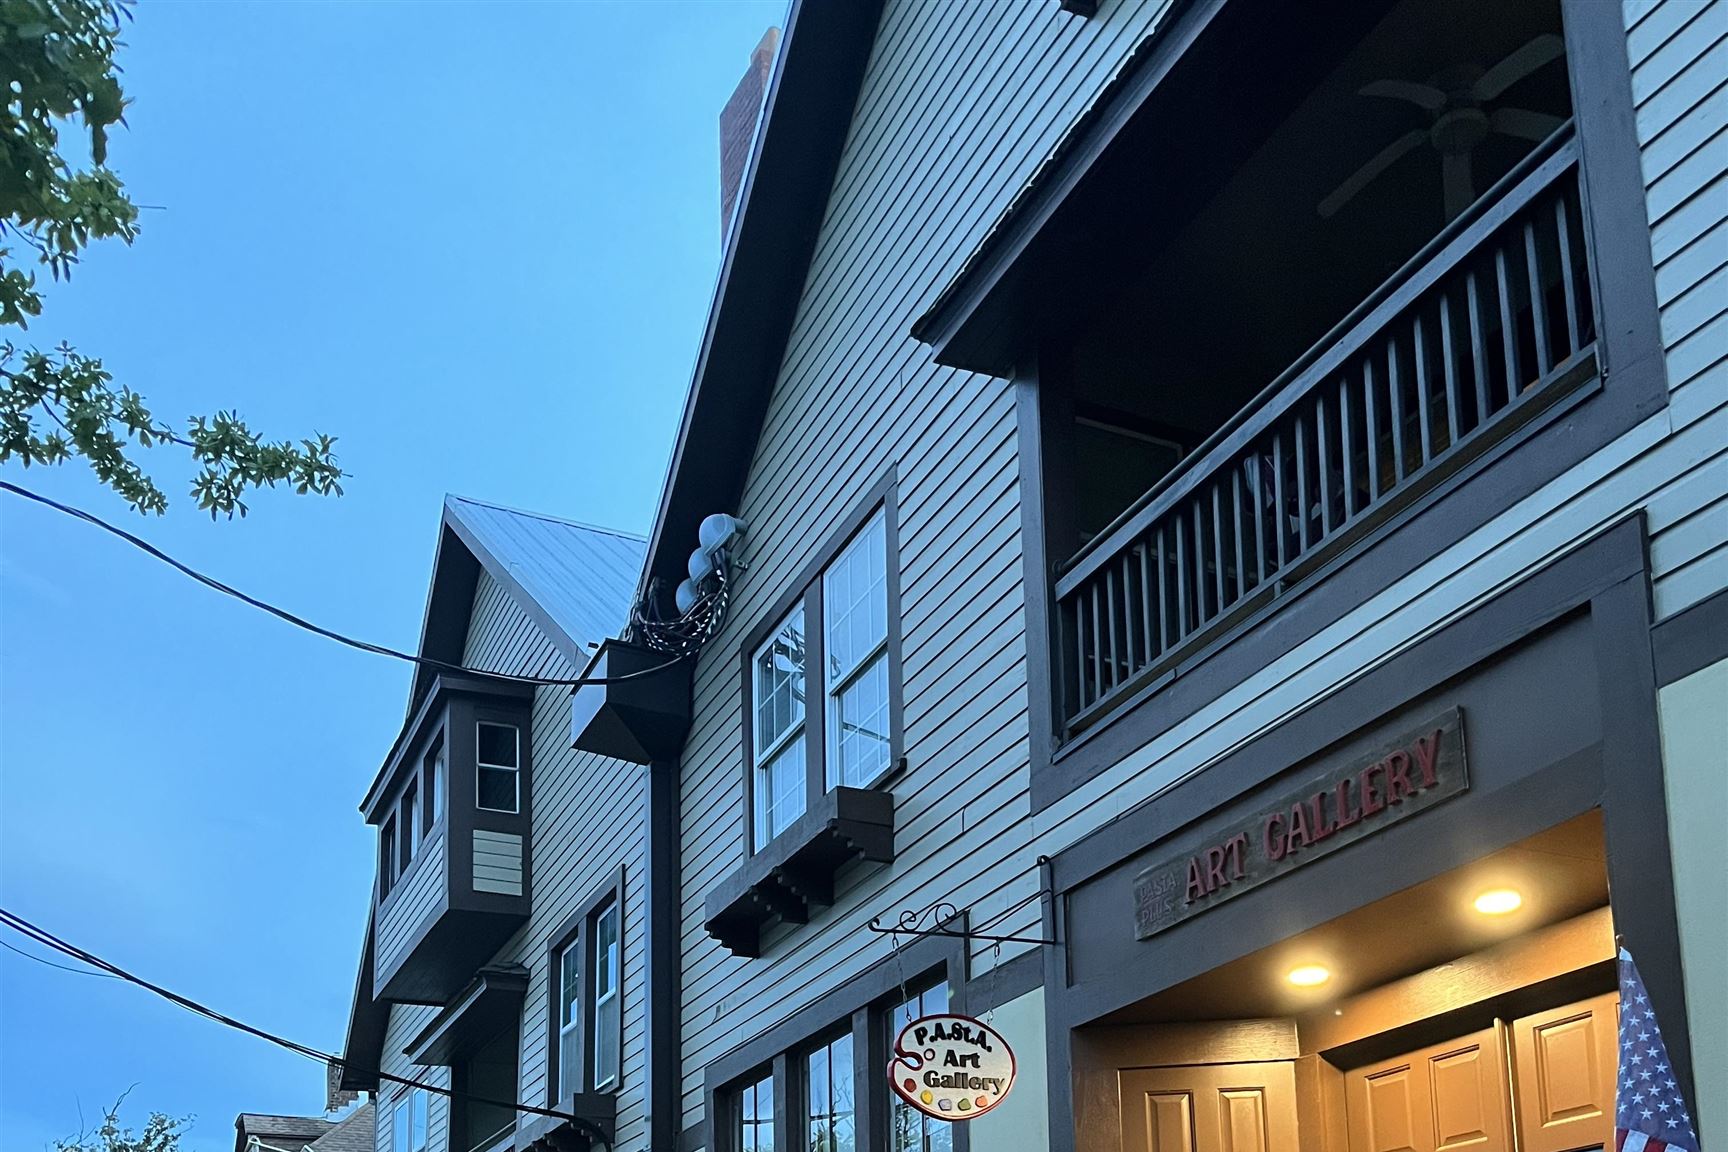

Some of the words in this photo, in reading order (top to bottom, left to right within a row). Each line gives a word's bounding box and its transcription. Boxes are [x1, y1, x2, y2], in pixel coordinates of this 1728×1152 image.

[1184, 832, 1248, 905] ART
[1263, 728, 1444, 861] GALLERY
[943, 1049, 981, 1069] Art
[923, 1070, 1006, 1096] Gallery
